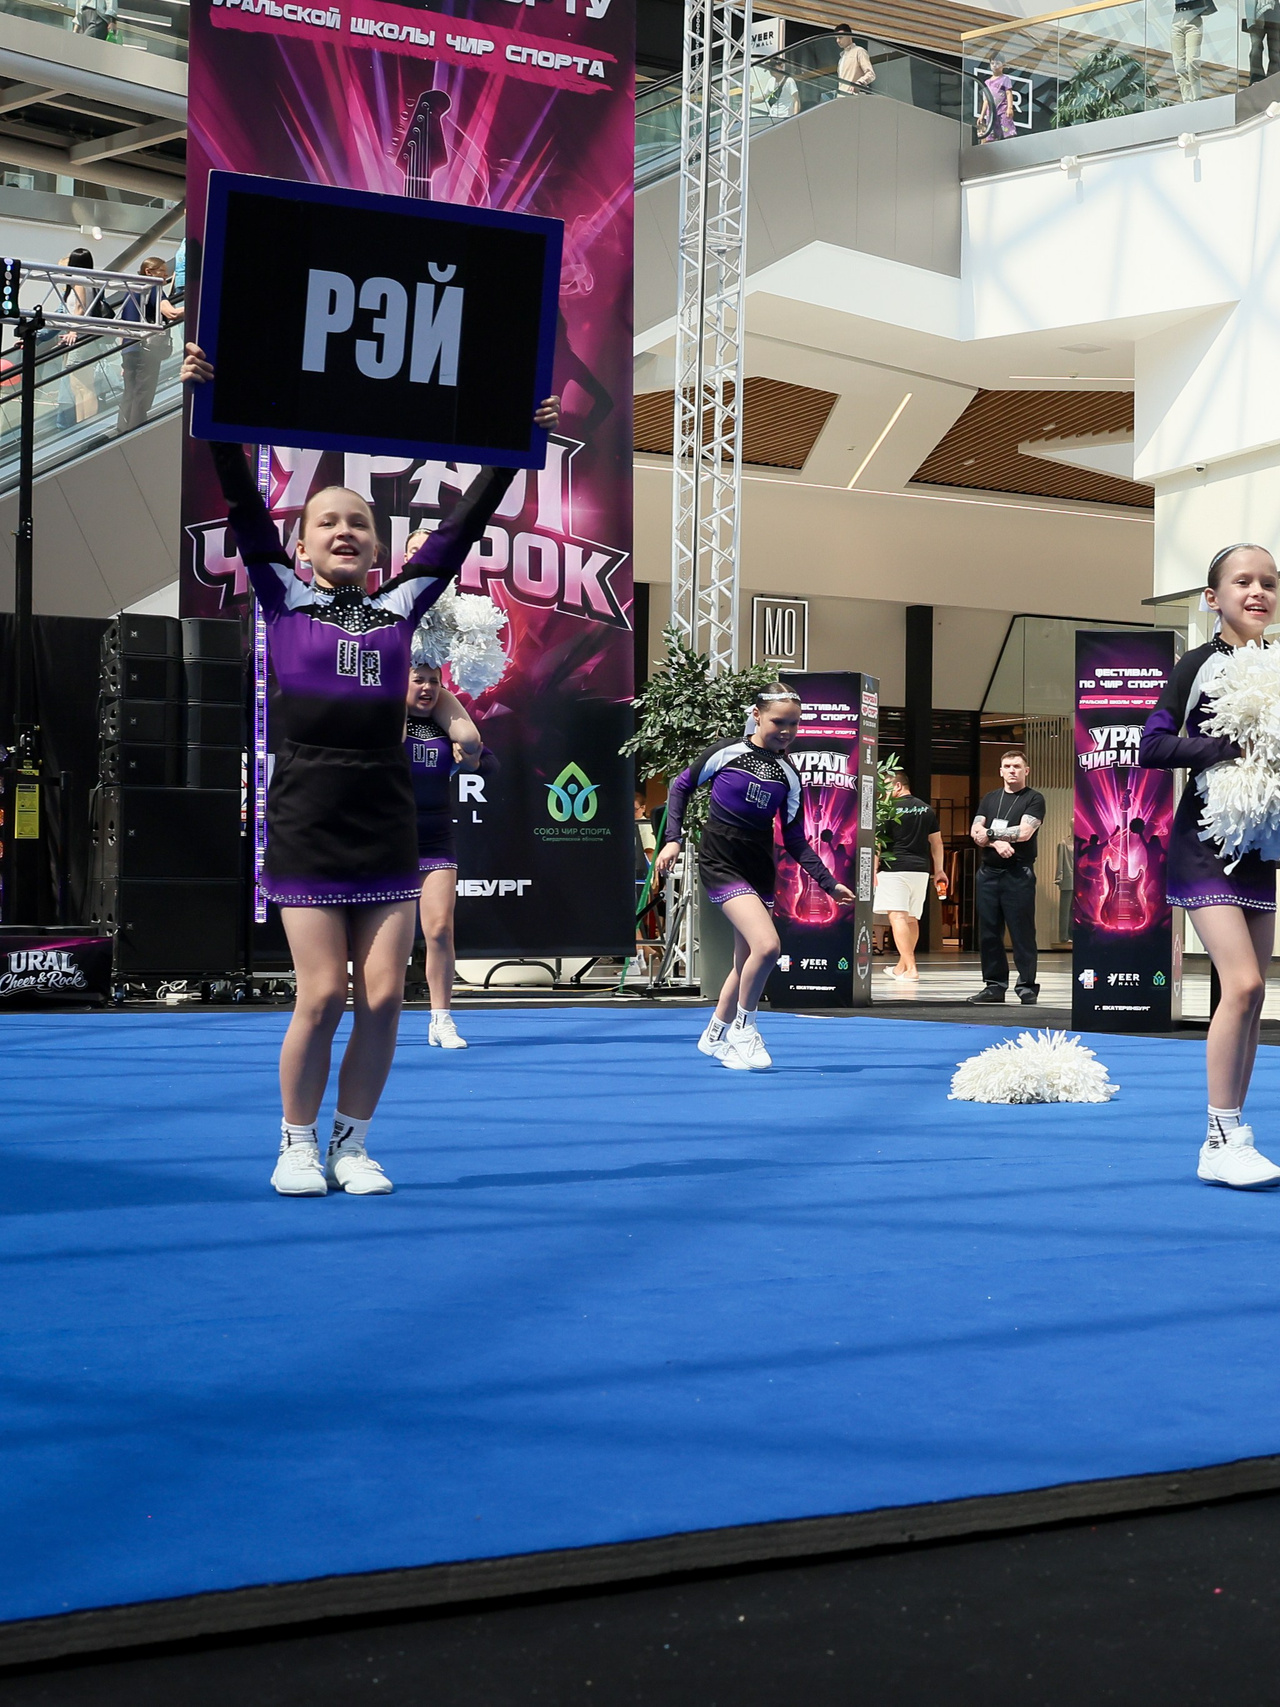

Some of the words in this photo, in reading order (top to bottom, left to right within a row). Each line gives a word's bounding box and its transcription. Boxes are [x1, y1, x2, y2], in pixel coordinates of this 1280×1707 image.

[351, 17, 436, 46] ШКОЛЫ
[446, 33, 495, 56] ЧИР
[505, 44, 605, 78] СПОРТА
[302, 261, 464, 387] РЭЙ
[460, 525, 616, 617] РОК
[765, 607, 796, 656] MO
[337, 639, 381, 686] UR
[1095, 668, 1163, 678] ФЕСТИВАЛЬ
[1079, 680, 1096, 688] ПО
[1100, 680, 1123, 688] ЧИР
[1127, 680, 1168, 688] СПОРТ
[800, 703, 850, 711] ЕСТИВАЛЬ
[820, 713, 858, 721] СПОРТУ
[1090, 727, 1140, 751] УРА
[413, 743, 438, 767] UR
[792, 752, 847, 773] УРАЛ
[1081, 751, 1117, 769] ЧИР
[825, 772, 855, 789] РОК
[10, 950, 76, 974] URAL
[0, 973, 37, 994] Cheer
[46, 971, 86, 988] Rock
